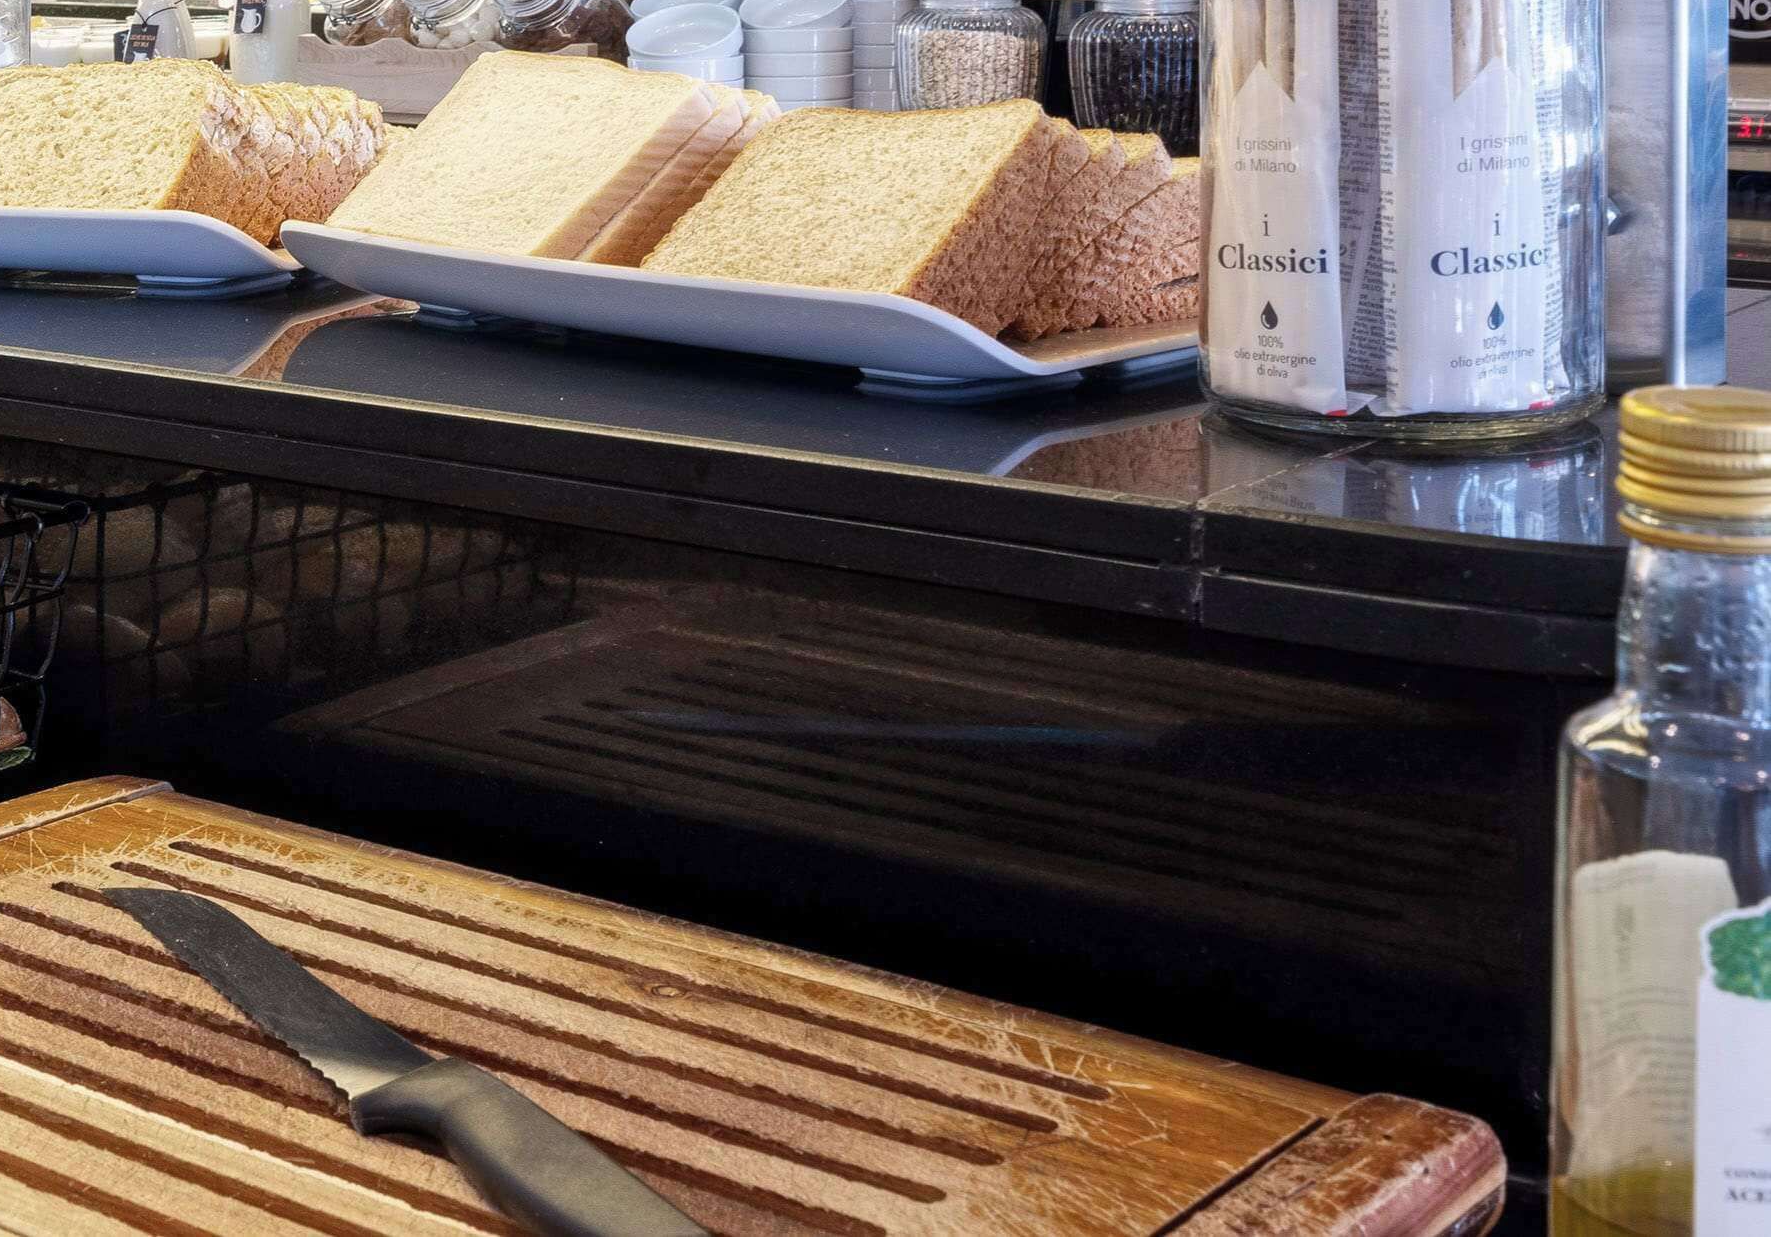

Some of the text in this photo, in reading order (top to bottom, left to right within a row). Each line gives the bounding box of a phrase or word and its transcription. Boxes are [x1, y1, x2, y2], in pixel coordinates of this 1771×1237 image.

[1243, 136, 1292, 154] grissini
[1471, 134, 1528, 154] grissini
[1234, 158, 1297, 173] di Milano
[1457, 156, 1530, 173] di Milano
[1262, 213, 1270, 237] i
[1493, 213, 1501, 237] i
[1217, 244, 1331, 274] Classici
[1257, 334, 1284, 349] 100%
[1234, 348, 1317, 368] olio extravergine
[1257, 364, 1289, 378] di oliva
